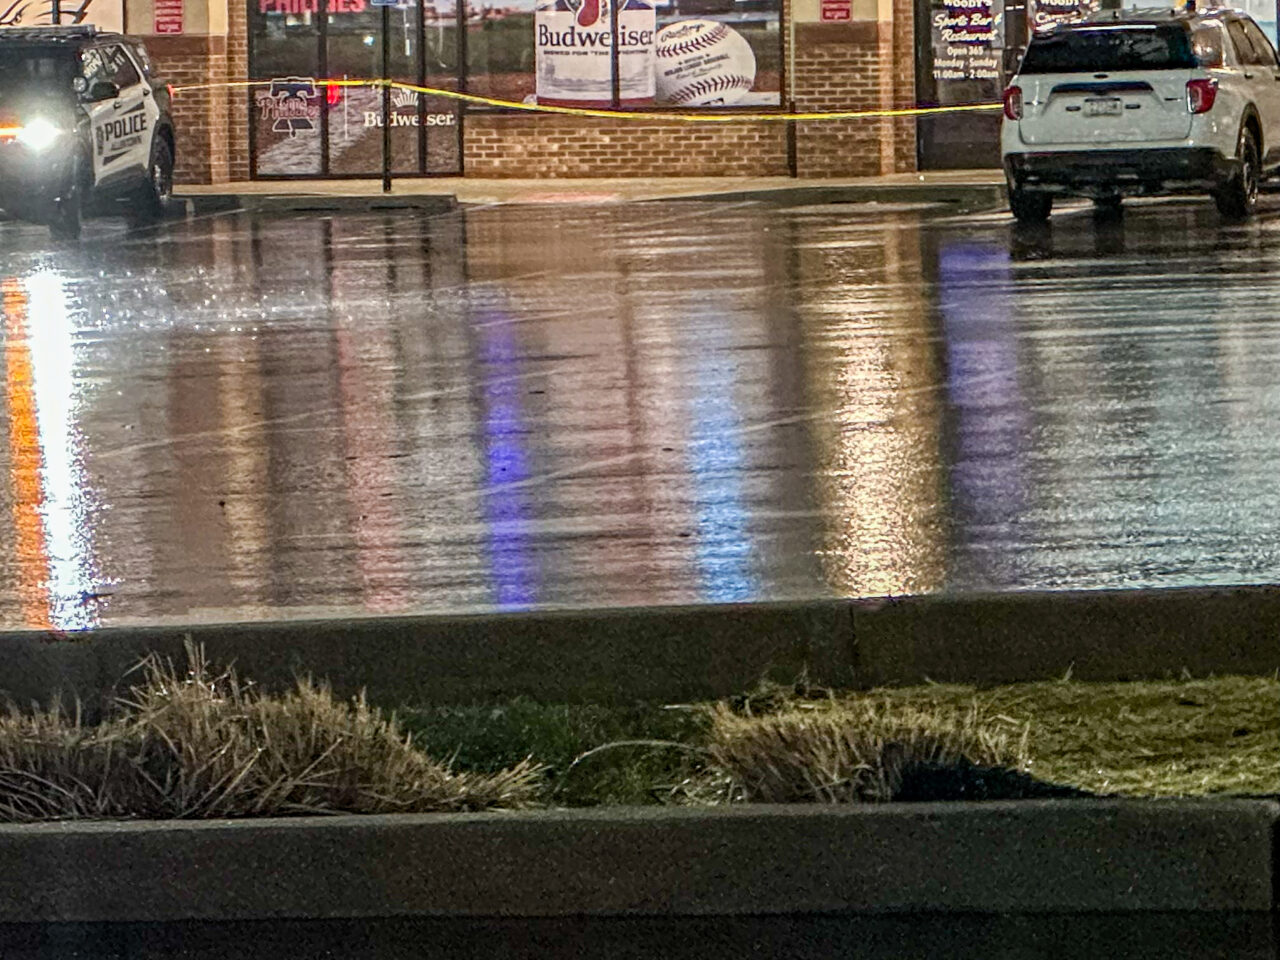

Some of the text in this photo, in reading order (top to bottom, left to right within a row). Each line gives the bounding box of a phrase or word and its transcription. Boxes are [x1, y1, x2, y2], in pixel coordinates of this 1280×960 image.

[970, 13, 992, 26] Bar
[539, 24, 653, 47] Budweiser
[947, 46, 967, 58] Open
[105, 113, 147, 141] POLICE
[364, 111, 456, 127] Budweser
